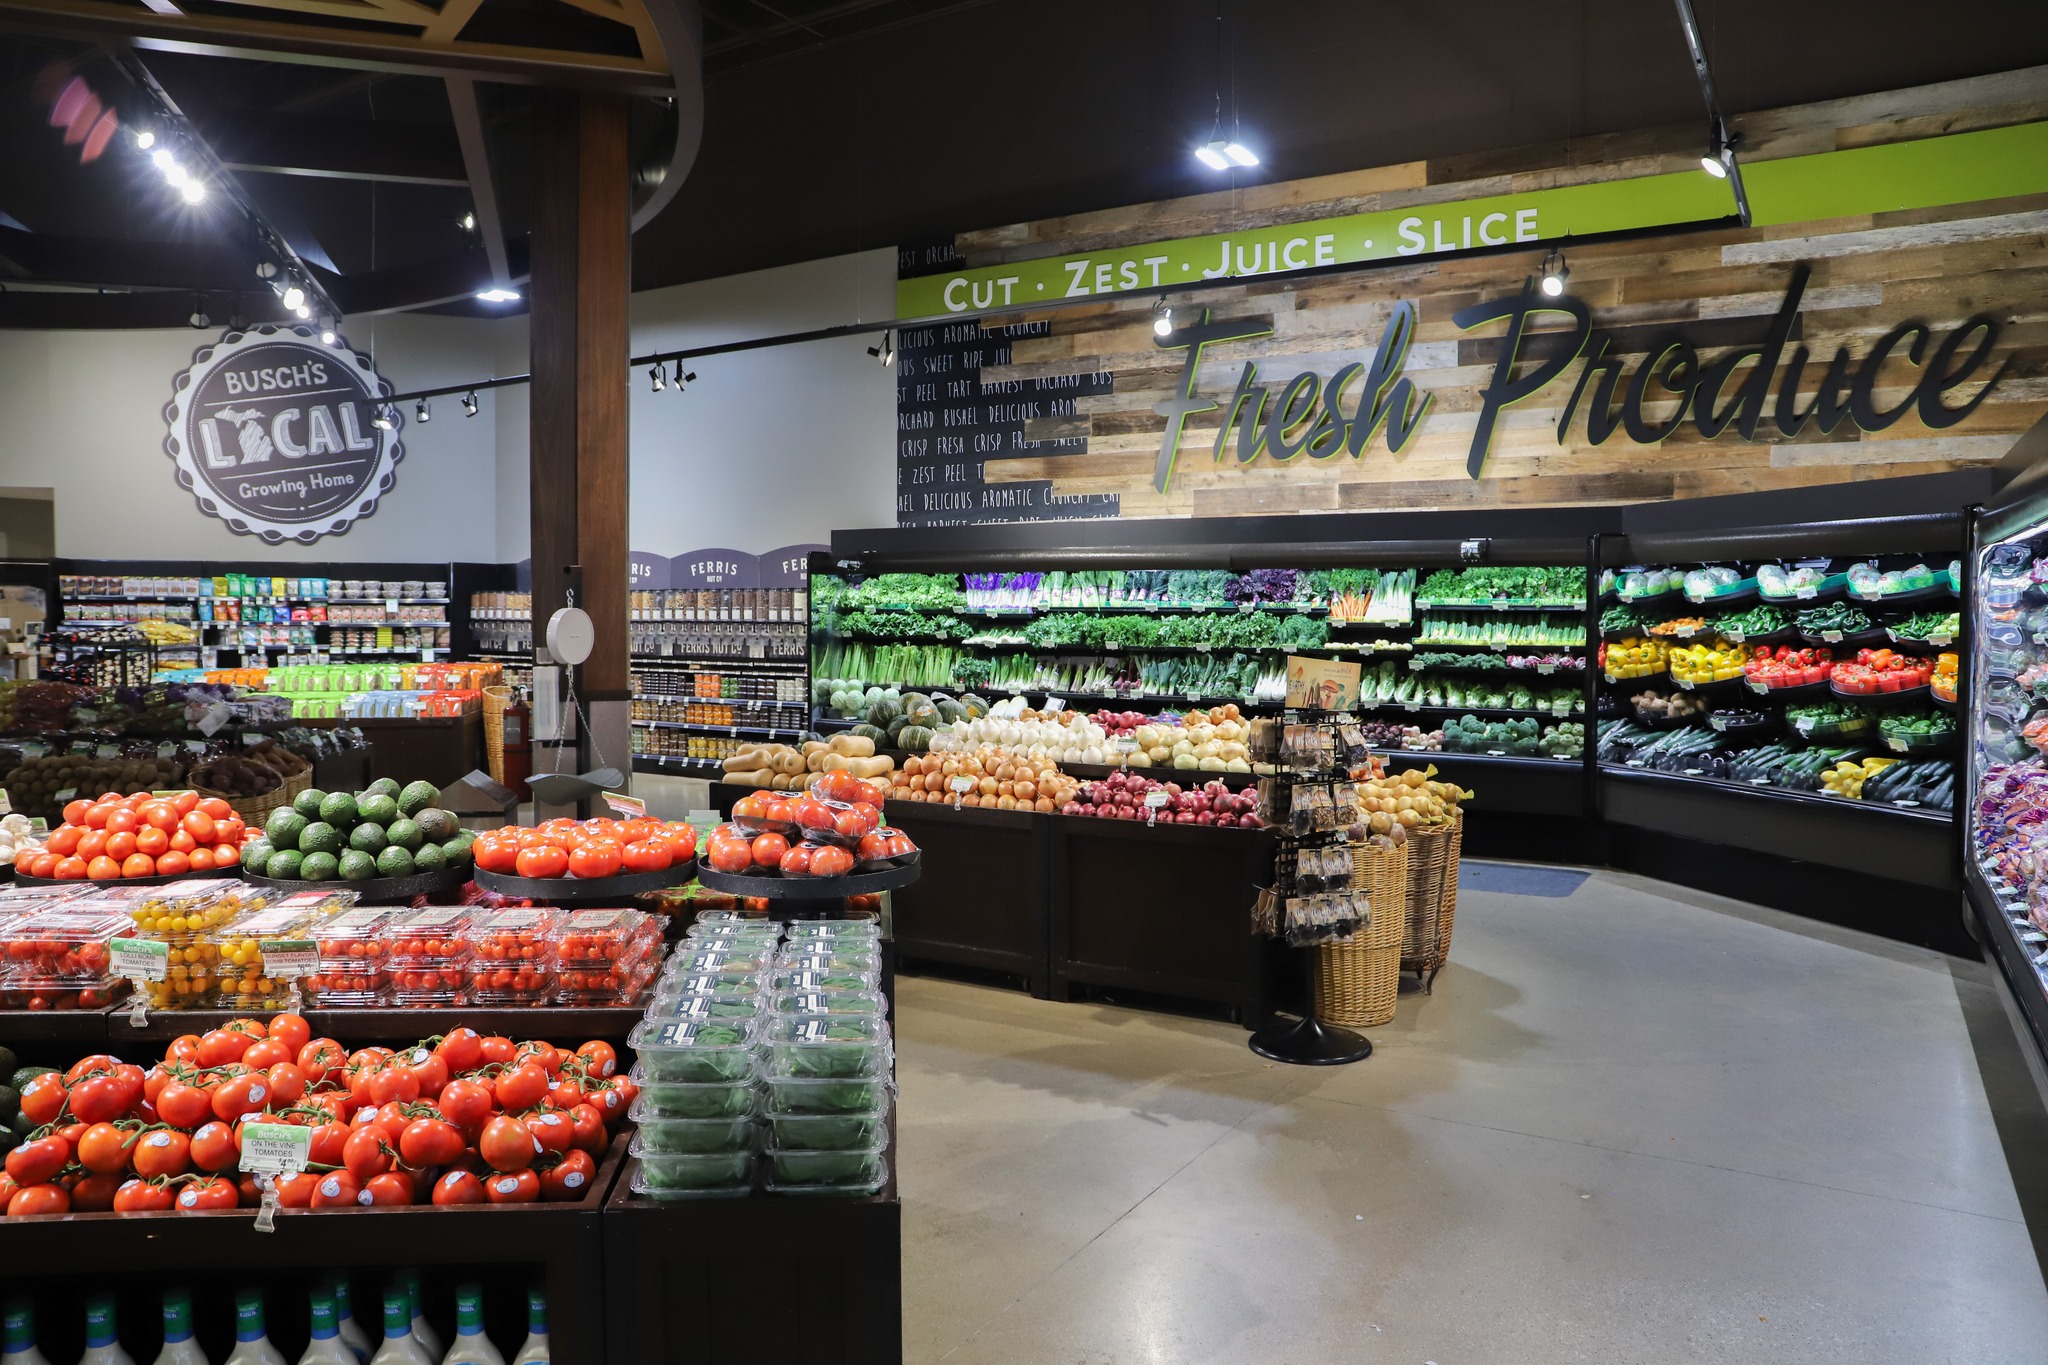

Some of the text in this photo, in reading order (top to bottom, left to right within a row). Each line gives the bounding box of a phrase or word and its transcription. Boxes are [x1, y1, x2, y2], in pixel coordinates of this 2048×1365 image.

[926, 244, 966, 266] ORCHA
[944, 207, 1540, 312] CUT ZEST JUICE SLICE
[924, 354, 954, 374] SWEET
[963, 350, 984, 370] RIPE
[224, 359, 329, 395] BUSCH'S
[1152, 266, 2017, 494] Fresh Produce
[916, 382, 937, 402] PEEL
[947, 379, 972, 399] TART
[944, 406, 978, 427] BUSHEL
[989, 401, 1041, 423] DELICIOUS
[901, 438, 928, 458] CRISP
[937, 436, 964, 455] FRESH
[974, 432, 1002, 453] CRISP
[913, 465, 936, 484] ZEST
[945, 463, 967, 482] PEEL
[238, 472, 355, 499] Growing Home
[924, 491, 973, 511] DELICIOUS
[982, 487, 1033, 509] AROMATIC
[690, 560, 738, 577] FERRIS
[120, 952, 156, 961] LOLLI BOMB
[123, 944, 153, 954] BUSCH'S
[122, 958, 156, 968] TOMATOES
[257, 1130, 292, 1140] BUSCH'S
[263, 1141, 278, 1149] THE
[279, 1142, 296, 1150] VINE
[254, 1148, 293, 1158] TOMATOES
